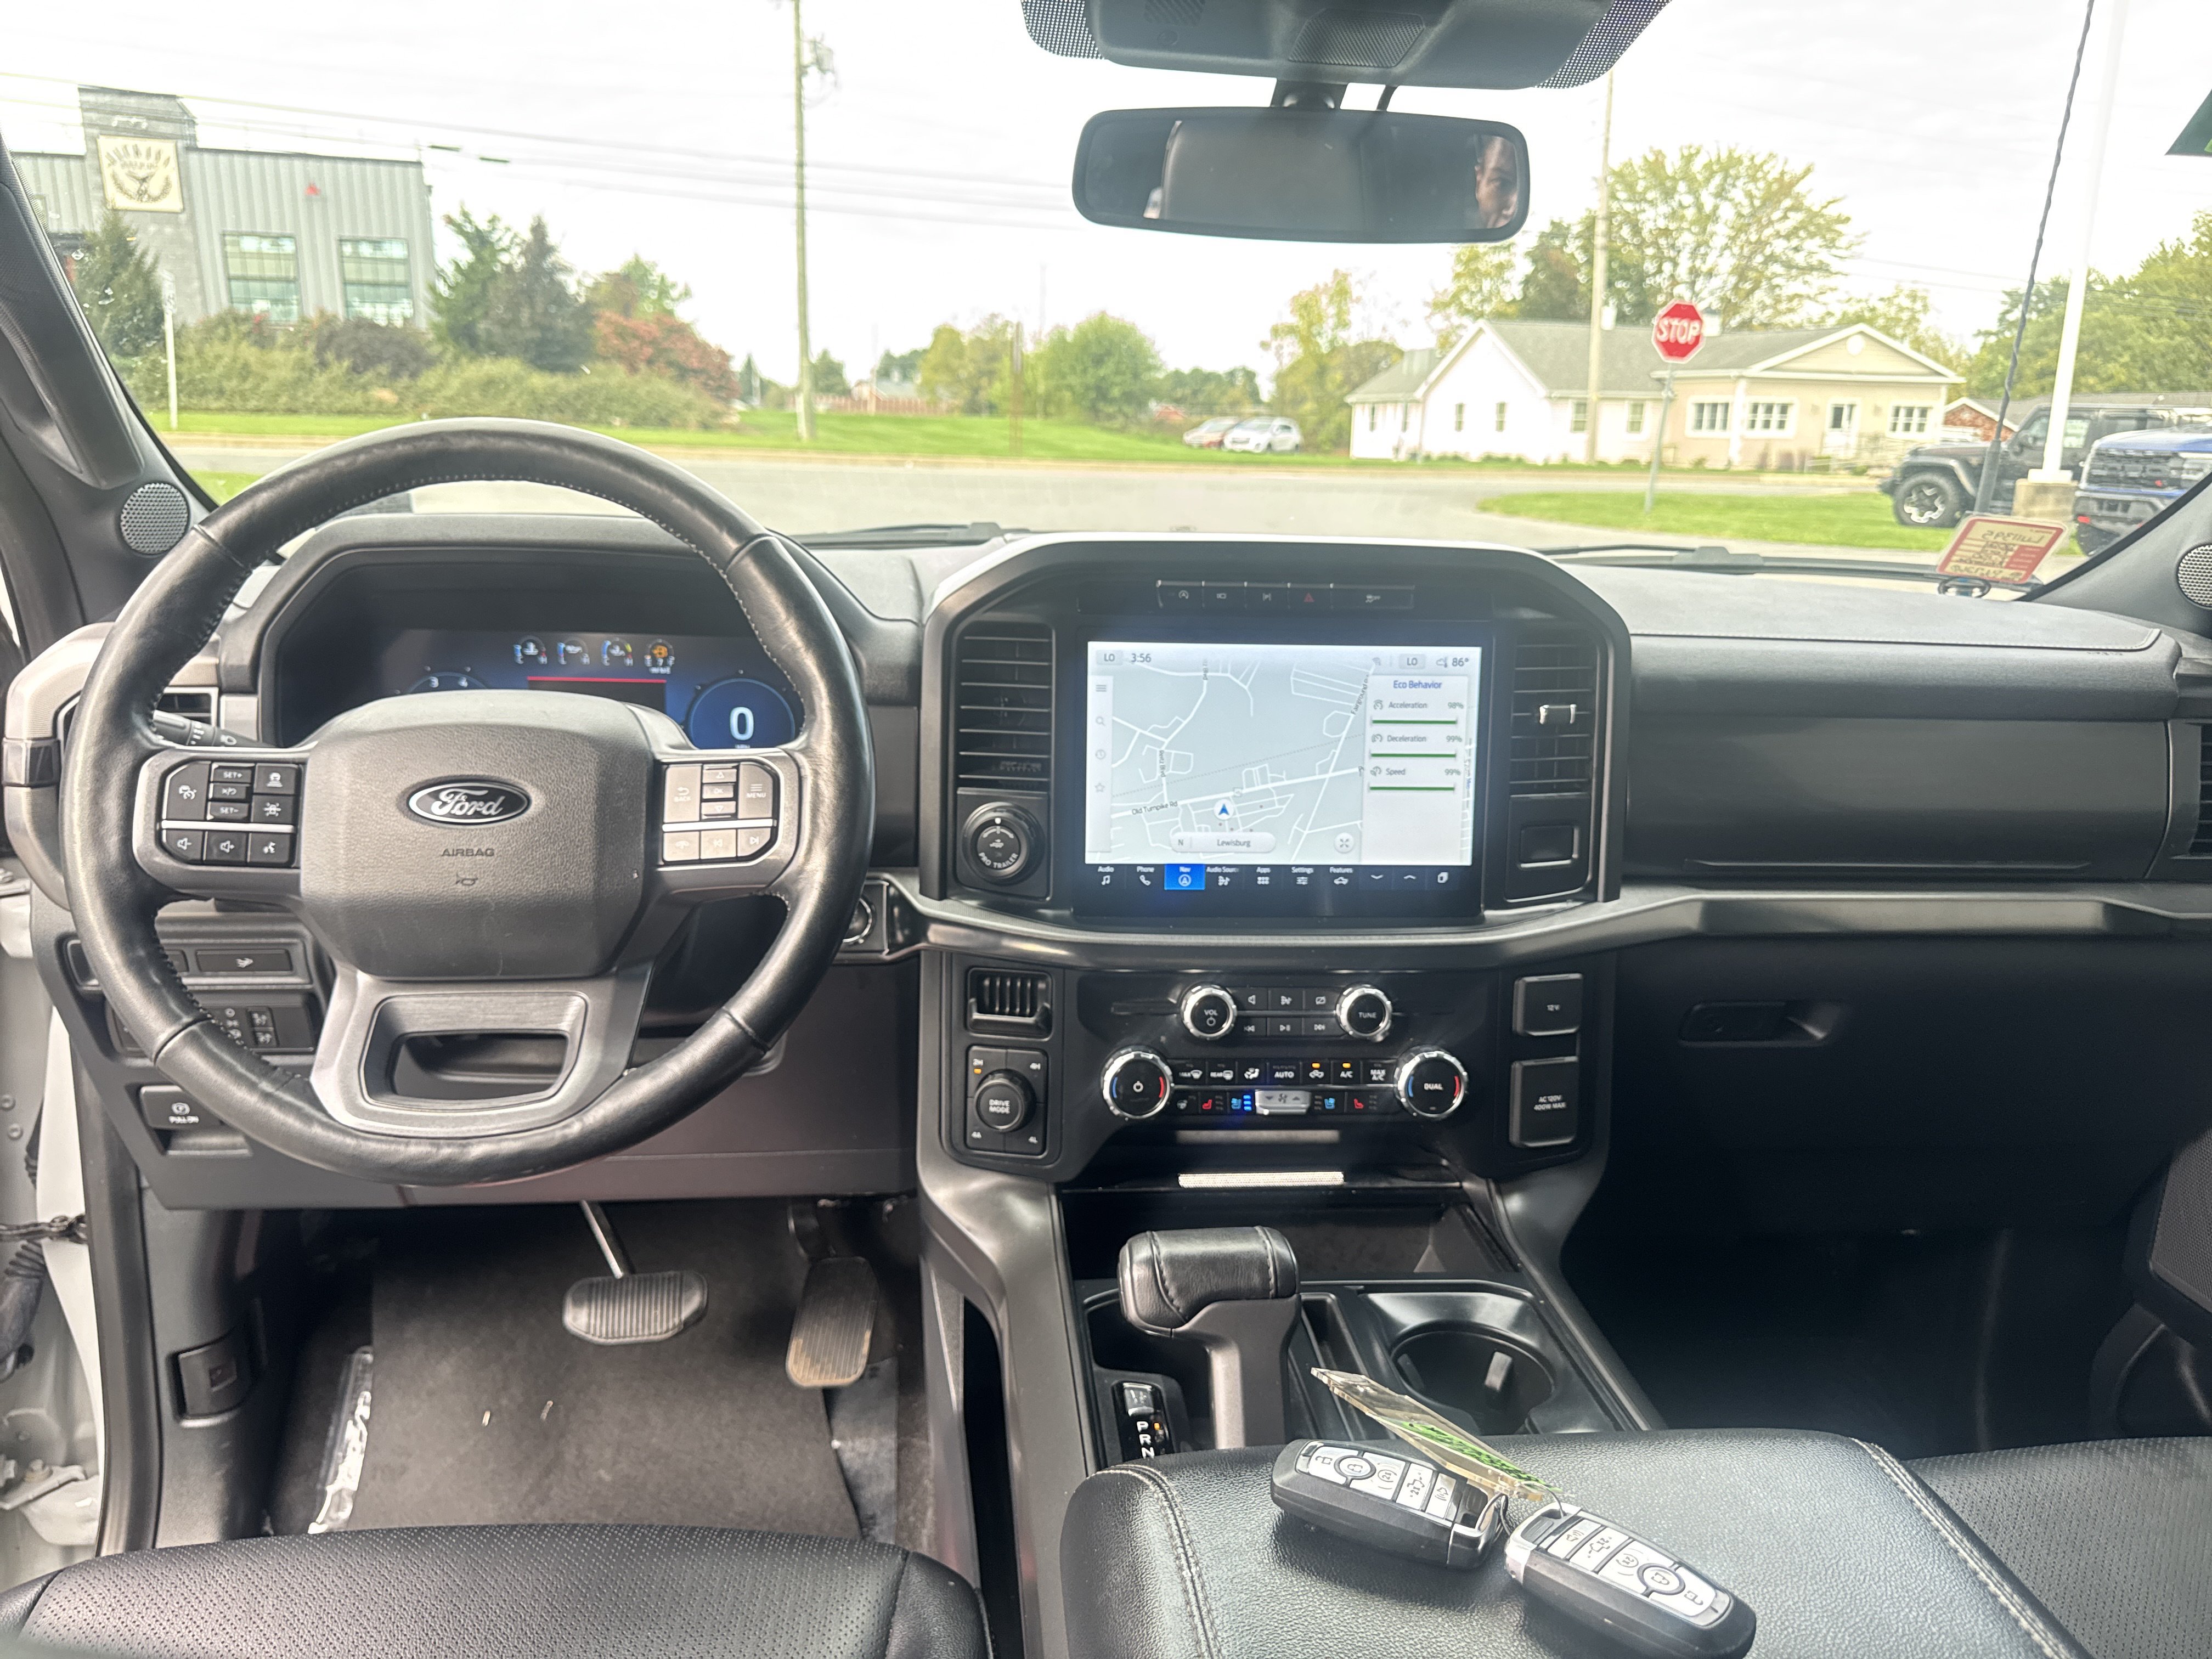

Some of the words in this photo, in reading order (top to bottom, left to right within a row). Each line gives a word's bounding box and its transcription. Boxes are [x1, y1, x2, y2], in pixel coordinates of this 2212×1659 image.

[1657, 316, 1700, 345] STOP
[1104, 653, 1115, 662] LO
[1131, 653, 1152, 663] 3:56
[1452, 657, 1469, 667] 86°
[1393, 680, 1407, 689] Eco
[1409, 680, 1442, 689] Behavior
[730, 707, 754, 741] 0
[431, 788, 505, 815] Ford
[442, 848, 495, 857] AIRBAG
[993, 853, 1019, 868] TRAILER
[989, 1106, 1011, 1114] MODE
[1137, 1421, 1148, 1432] P
[1139, 1434, 1151, 1446] R
[1141, 1447, 1155, 1459] N
